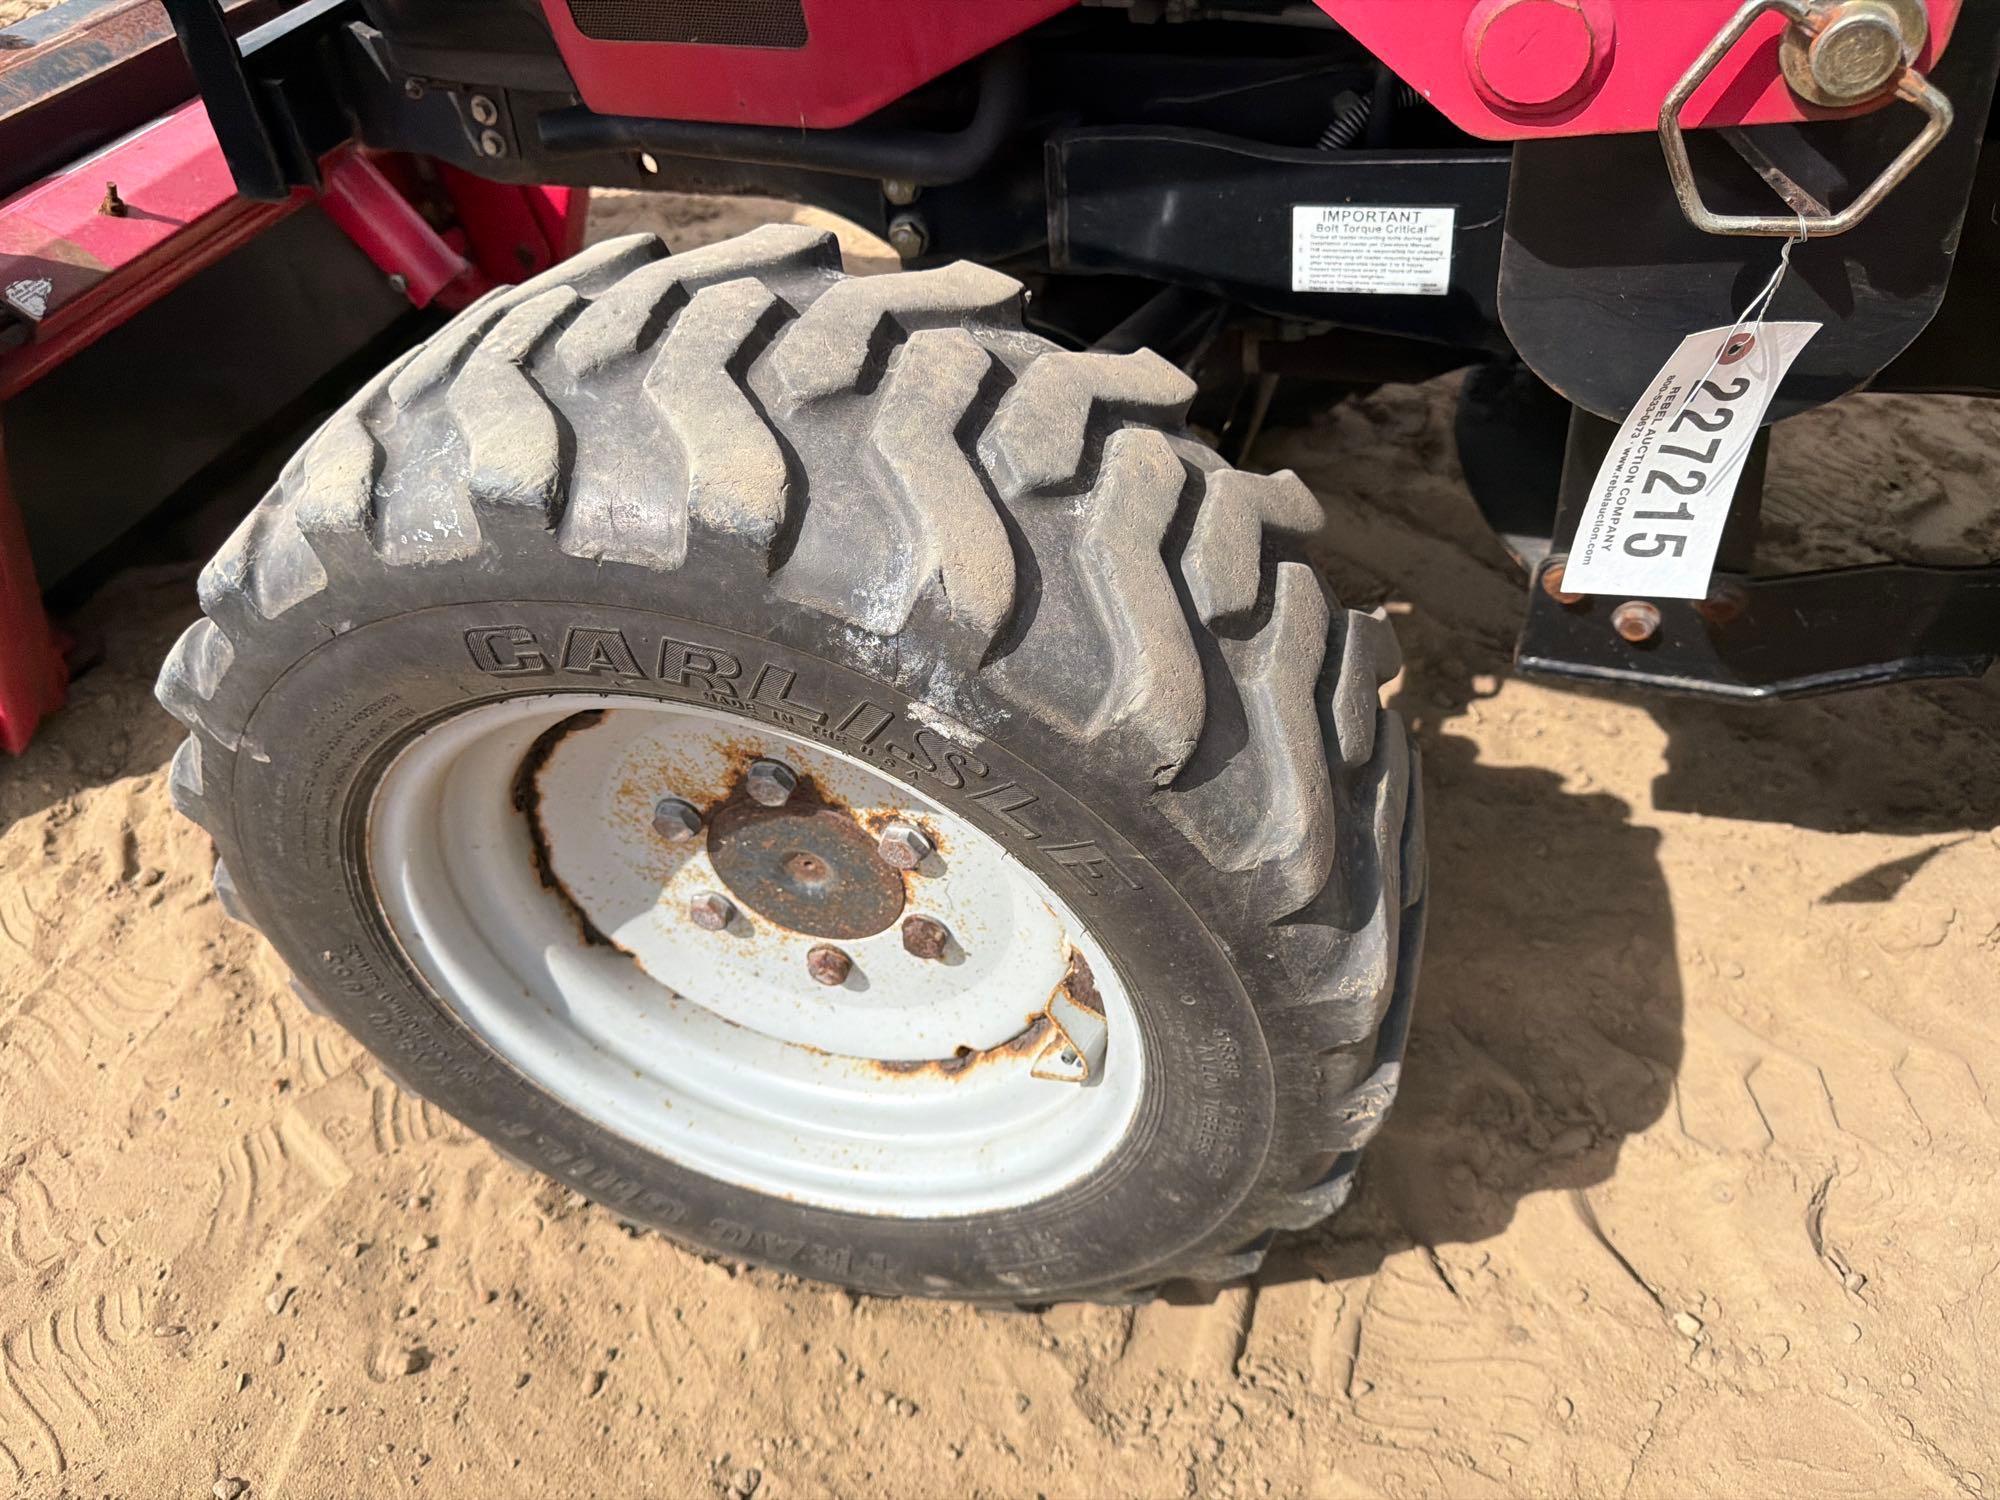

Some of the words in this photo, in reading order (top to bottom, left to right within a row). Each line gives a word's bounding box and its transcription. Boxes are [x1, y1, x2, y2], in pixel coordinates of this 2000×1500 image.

[1316, 223, 1339, 233] Bolt
[1343, 224, 1382, 234] Torque
[1385, 225, 1428, 234] Critical
[1322, 210, 1421, 223] IMPORTANT
[1631, 374, 1676, 439] 800-533-0673
[1651, 386, 1682, 430] REBEL
[1623, 377, 1750, 558] 227215
[1628, 429, 1656, 485] AUCTION
[1582, 447, 1630, 566] www.rebelauction.com
[1601, 487, 1630, 552] COMPANY
[463, 624, 1143, 896] CARLISLE
